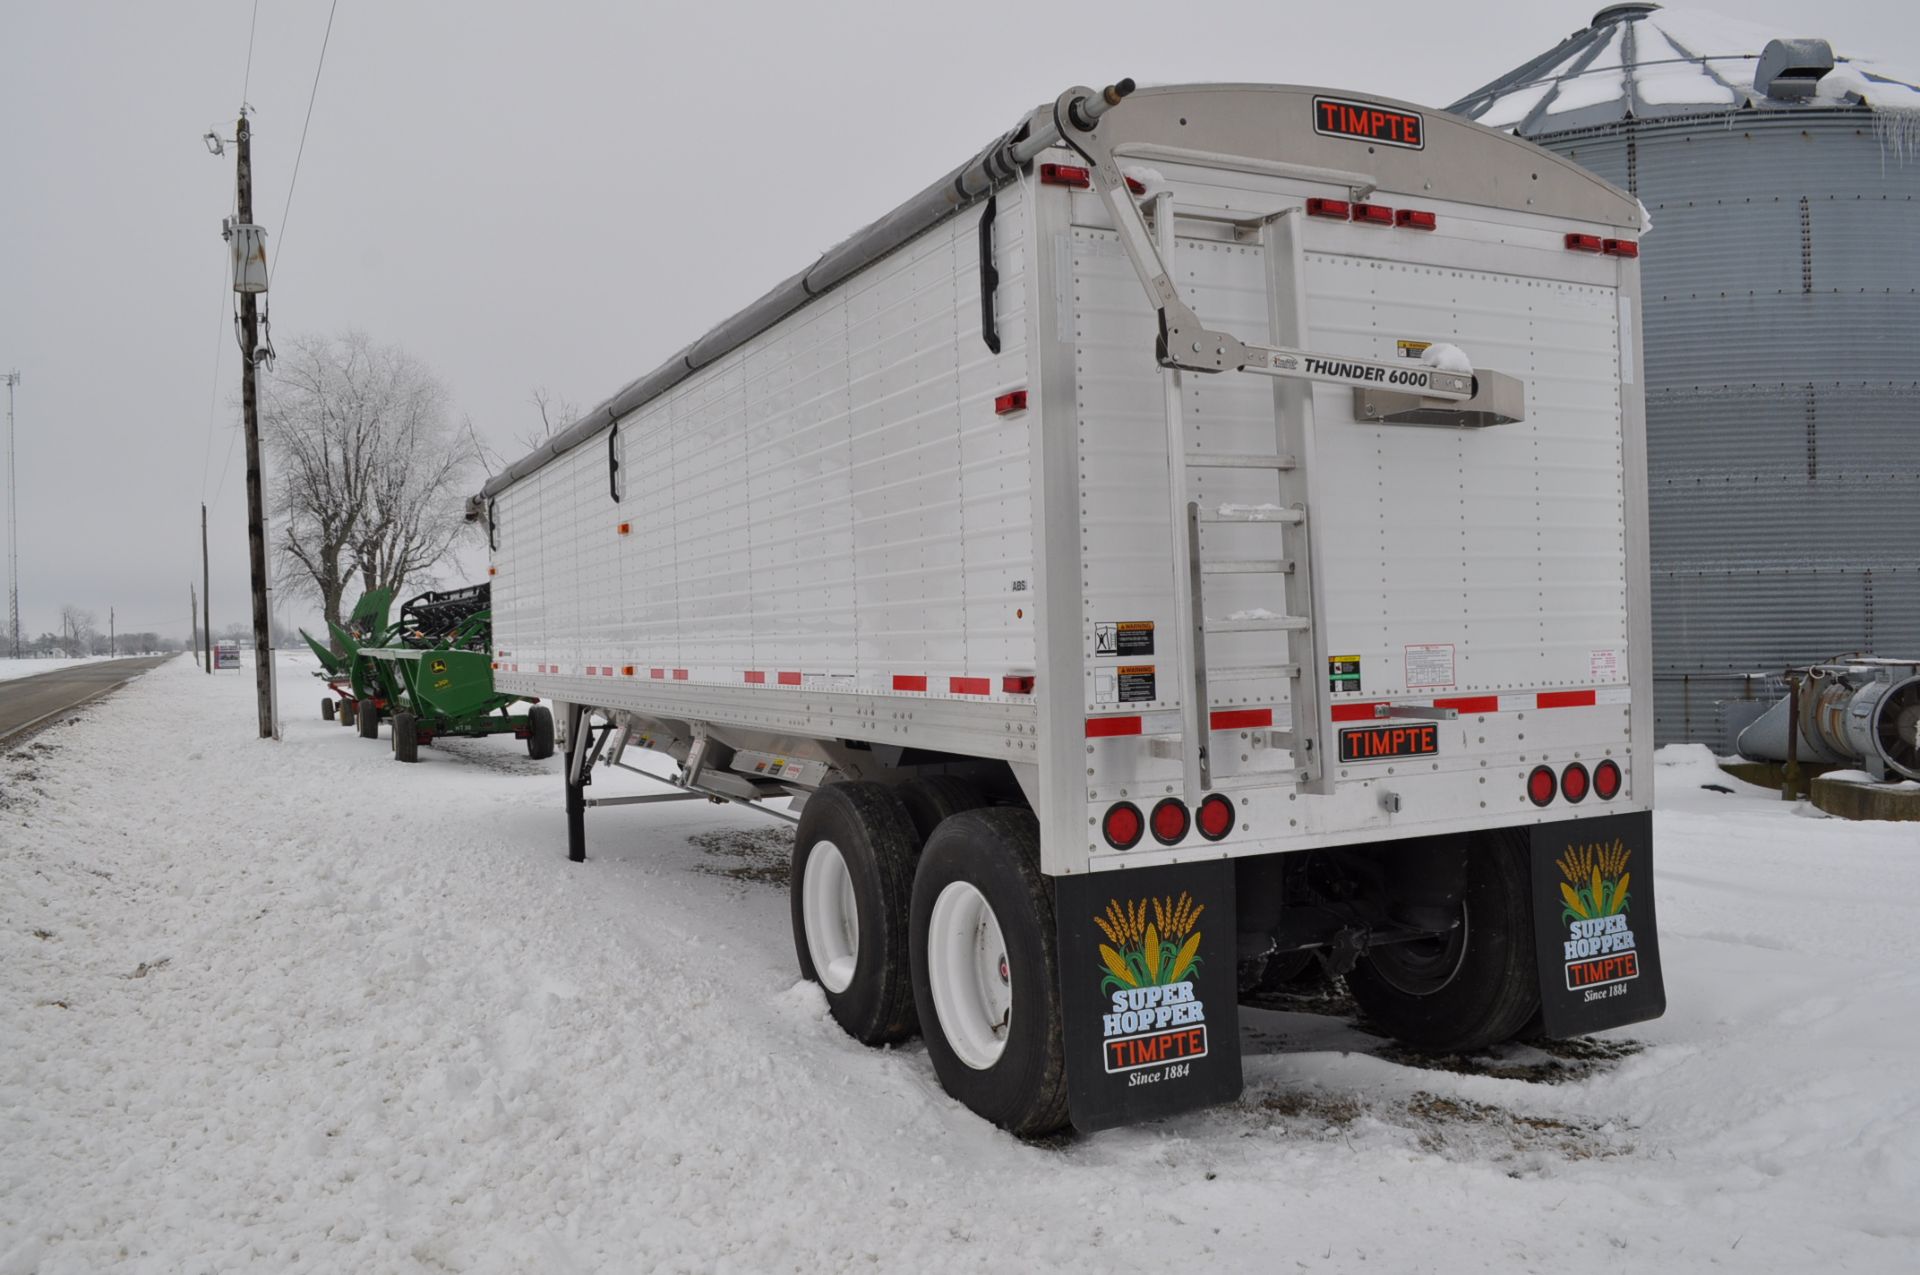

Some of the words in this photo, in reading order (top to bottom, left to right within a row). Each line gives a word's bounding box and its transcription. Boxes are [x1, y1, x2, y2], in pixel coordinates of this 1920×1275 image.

[1321, 103, 1417, 143] TIMPTE
[1304, 358, 1385, 382] THUNDER
[1389, 370, 1428, 387] 6000
[1012, 580, 1026, 592] ABS
[1346, 727, 1435, 758] TIMPTE
[1570, 913, 1628, 940] SUPER
[1564, 931, 1636, 960] HOPPER
[1570, 955, 1635, 985] TIMPTE
[1111, 981, 1195, 1013] SUPER
[1584, 990, 1607, 1002] Since
[1608, 983, 1628, 997] 1884
[1103, 1001, 1205, 1037] HOPPER
[1111, 1029, 1203, 1067] TIMPTE
[1128, 1071, 1161, 1087] Since
[1164, 1063, 1190, 1080] 1884
